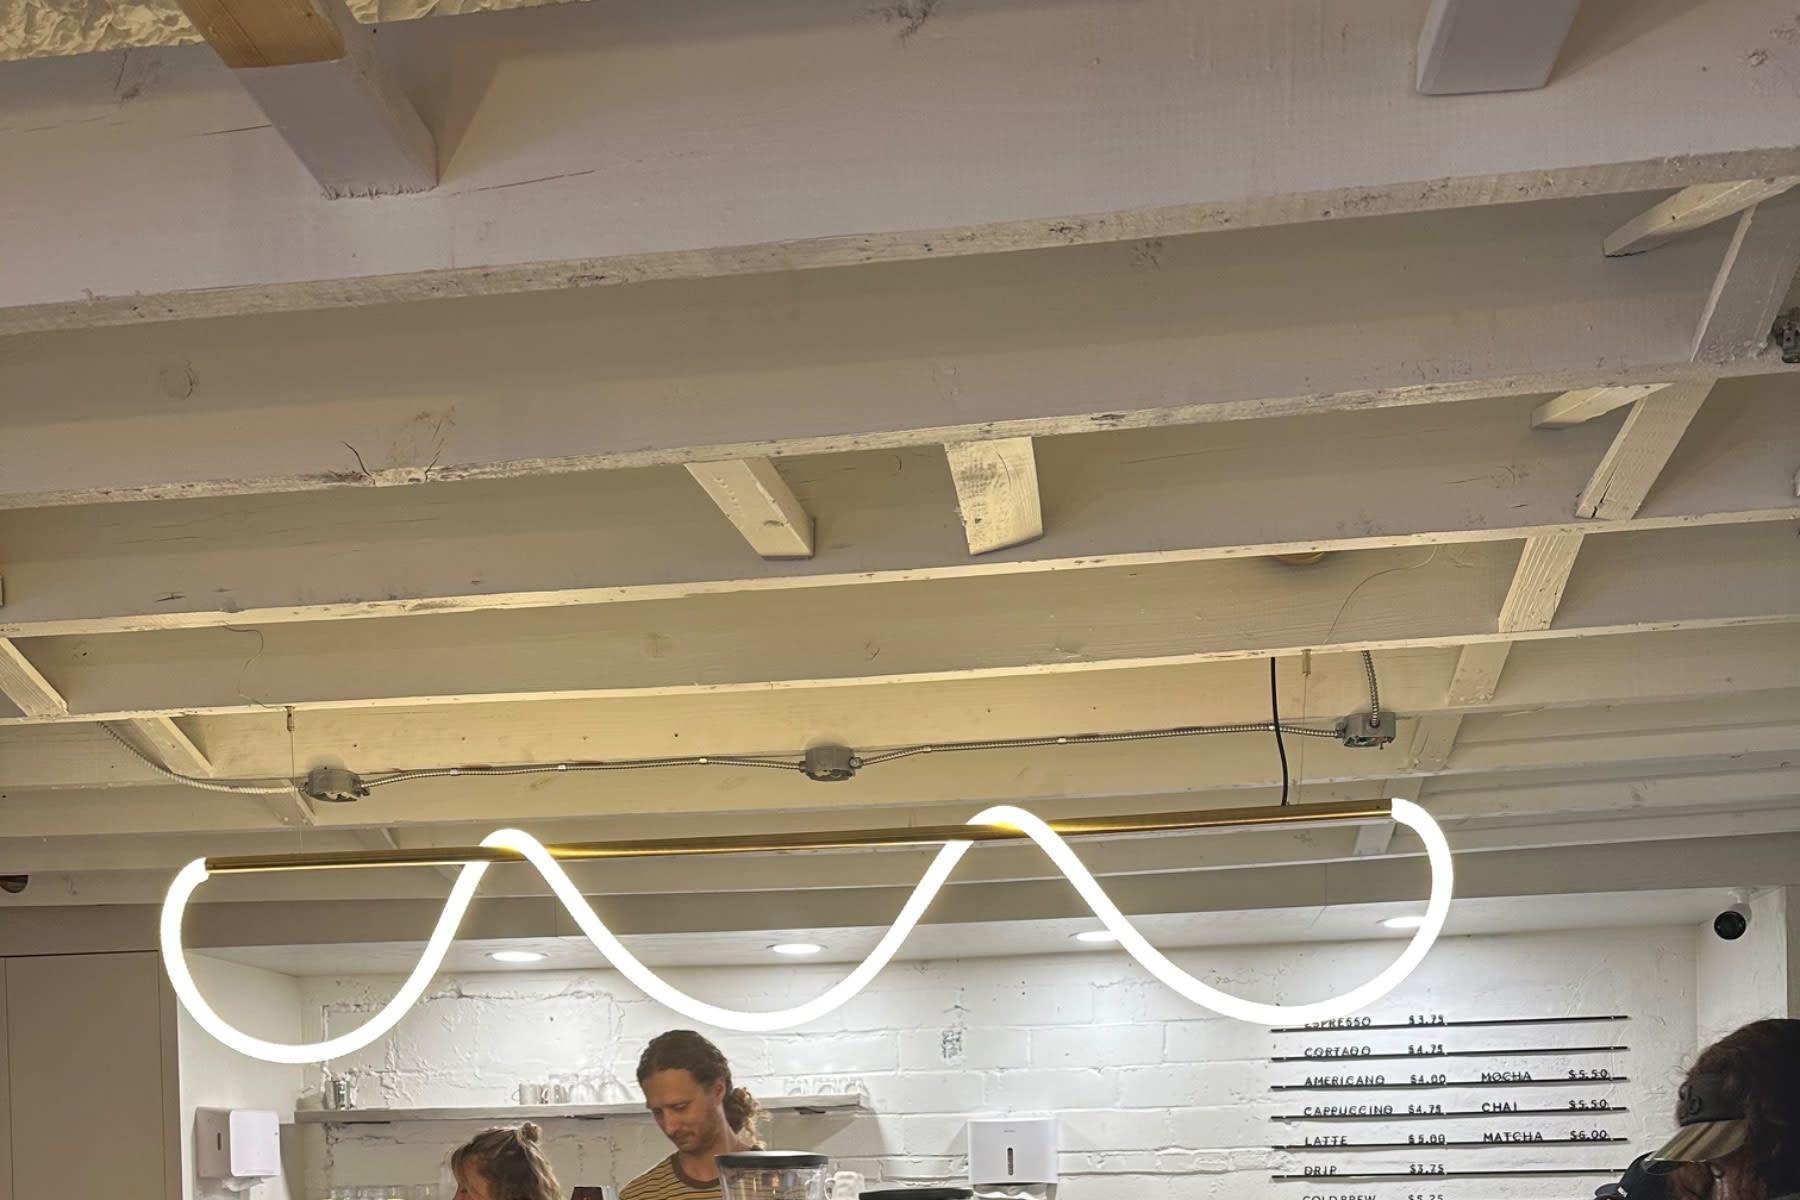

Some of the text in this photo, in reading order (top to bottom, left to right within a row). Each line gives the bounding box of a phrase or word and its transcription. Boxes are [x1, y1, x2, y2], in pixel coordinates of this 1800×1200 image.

[1408, 1014, 1444, 1025] $3.75
[1304, 1044, 1444, 1057] CORTADO $4.75
[1304, 1073, 1446, 1087] AMERICANO $4.00
[1481, 1068, 1608, 1082] MOCHA $5.50
[1304, 1104, 1443, 1117] CAPPUCCINO $4.75
[1481, 1098, 1608, 1113] CHAI $5.50
[1304, 1133, 1446, 1146] LATTE $5.00
[1483, 1129, 1608, 1143] MATCHA $6.00
[1304, 1164, 1444, 1176] DRIP $3.75
